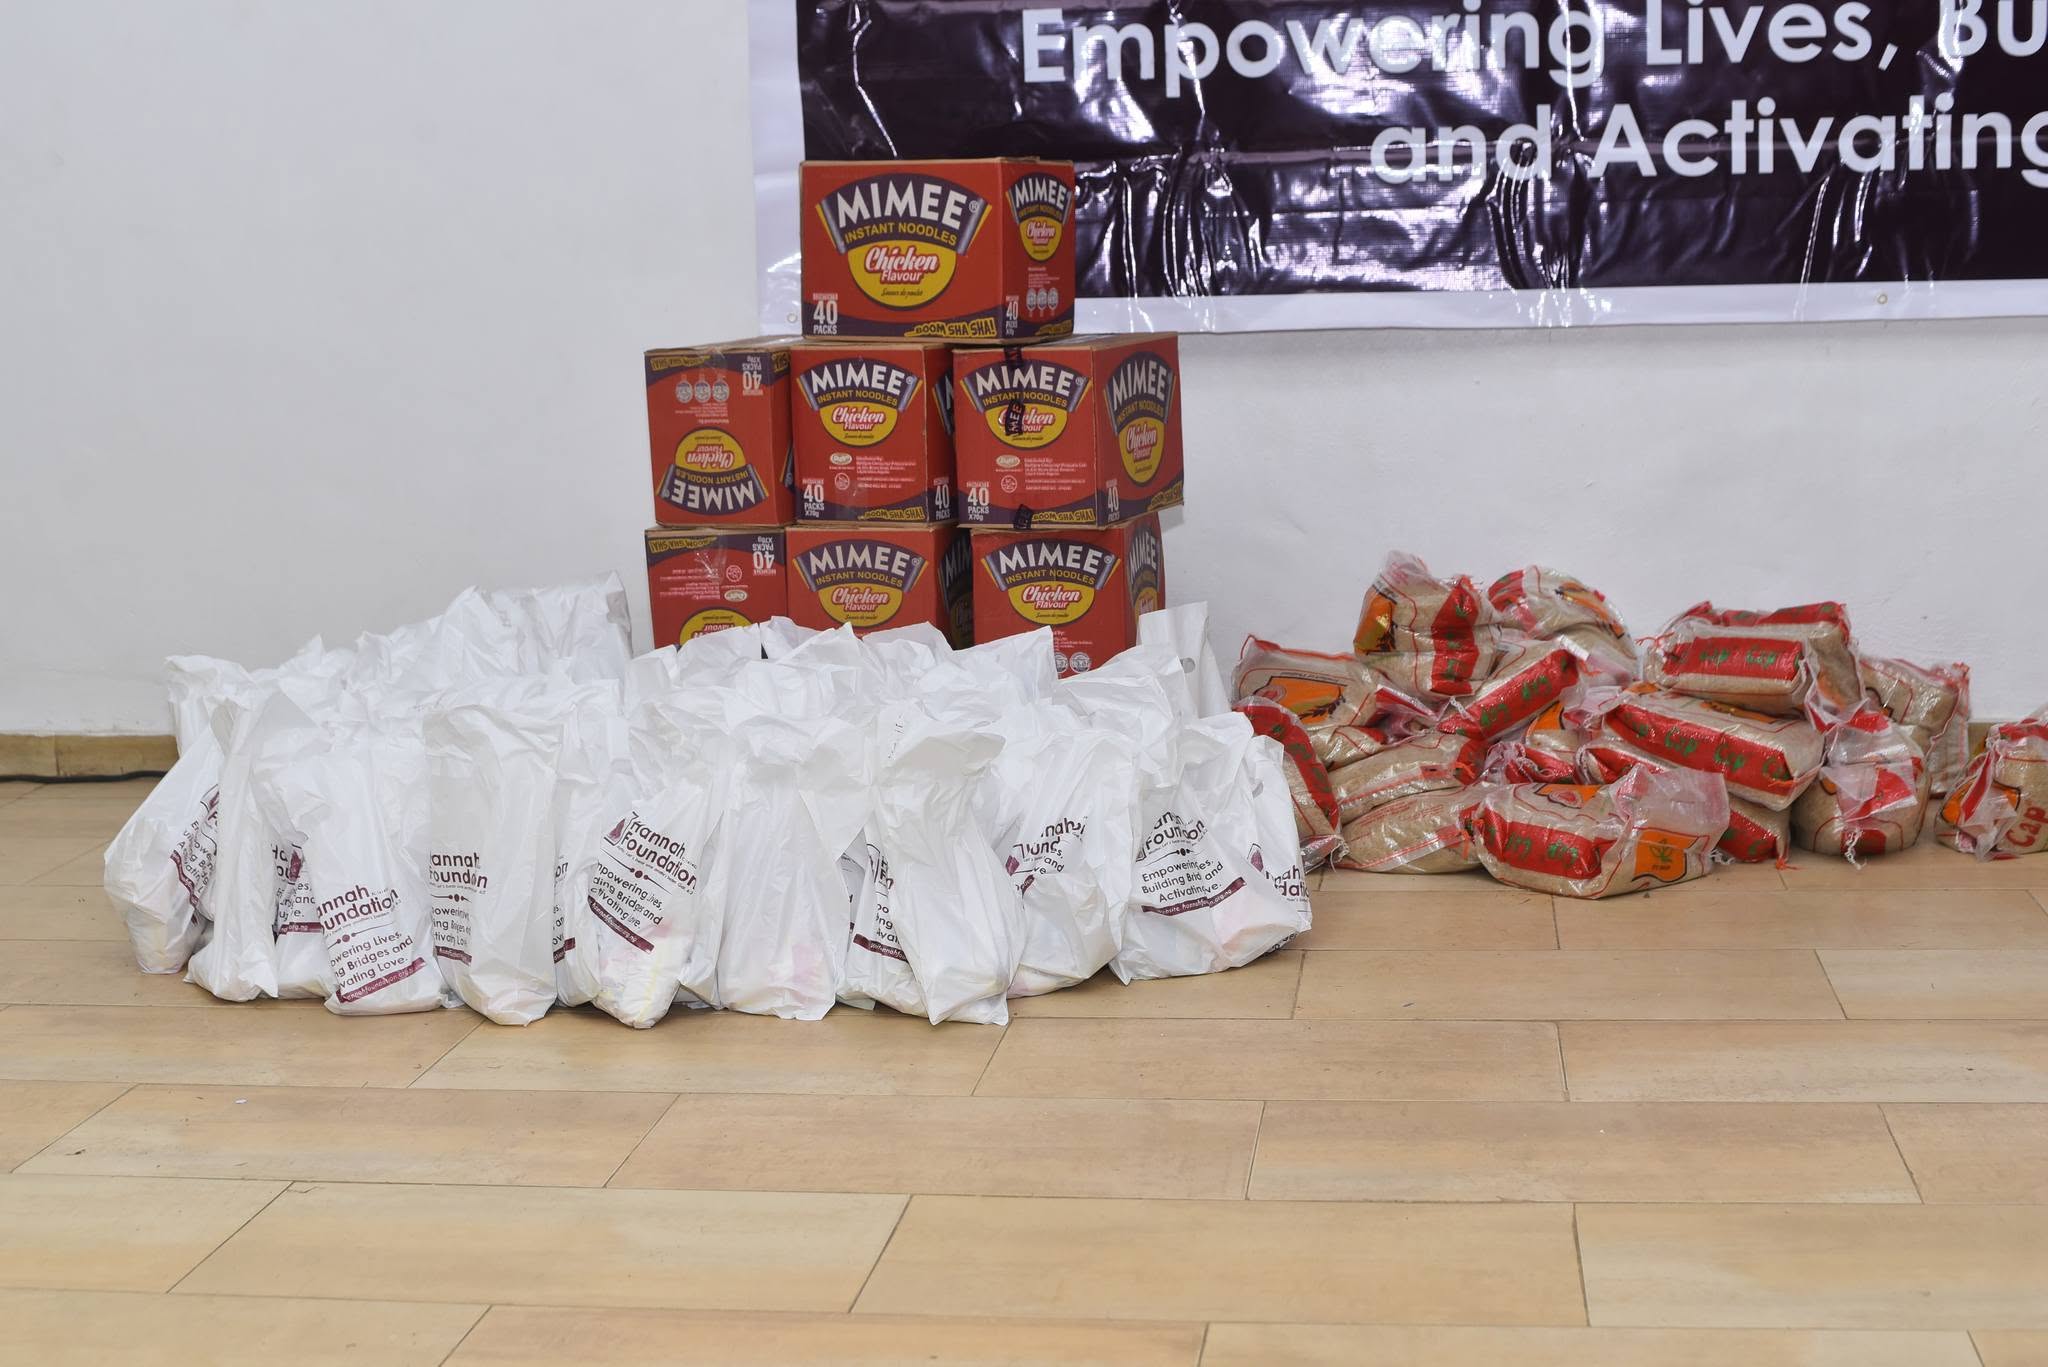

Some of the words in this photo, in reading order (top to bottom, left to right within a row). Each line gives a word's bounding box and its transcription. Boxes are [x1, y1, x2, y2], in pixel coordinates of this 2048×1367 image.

[1021, 0, 1606, 98] Empowering
[1646, 0, 1898, 71] Lives,
[1370, 103, 1551, 184] and
[1015, 178, 1067, 210] MIMEE
[837, 180, 967, 230] MIMEE
[844, 223, 895, 245] INSTANT
[898, 223, 957, 246] NOODLES
[865, 246, 938, 271] Chicken
[881, 270, 922, 281] Flavour
[813, 300, 838, 324] 40
[1006, 302, 1018, 320] 40
[813, 324, 838, 335] PACKS
[948, 324, 968, 336] SHA
[742, 371, 762, 390] 40
[811, 363, 905, 396] MIMEE
[975, 365, 1074, 397] MIMEE
[1113, 360, 1167, 411] MIMEE
[817, 389, 853, 404] INSTANT
[855, 389, 898, 406] NOODLES
[982, 391, 1021, 407] INSTANT
[1023, 391, 1068, 407] NOODLES
[833, 406, 885, 424] Chicken
[1126, 424, 1157, 450] Chicken
[687, 451, 734, 468] Chicken
[671, 479, 755, 511] MIMEE
[803, 484, 824, 502] 40
[935, 484, 949, 509] 40
[967, 488, 989, 506] 40
[1108, 488, 1119, 512] 40
[804, 502, 824, 511] PACKS
[968, 506, 989, 514] PACKS
[753, 543, 774, 551] PACKS
[753, 551, 775, 569] 40
[810, 543, 911, 577] MIMEE
[998, 542, 1103, 575] MIMEE
[816, 571, 854, 585] INSTANT
[857, 571, 903, 587] NOODLES
[1005, 569, 1047, 584] INSTANT
[1049, 569, 1095, 585] NOODLES
[832, 587, 888, 604] Chicken
[1023, 586, 1080, 602] Chicken
[845, 603, 877, 611] Flavour
[1035, 601, 1068, 609] Flavour
[1044, 857, 1064, 873] and
[1142, 875, 1185, 894] Building
[1205, 862, 1224, 881] and
[645, 908, 664, 926] and
[347, 948, 389, 971] Bridges
[392, 936, 413, 954] and
[378, 957, 408, 972] Love.
